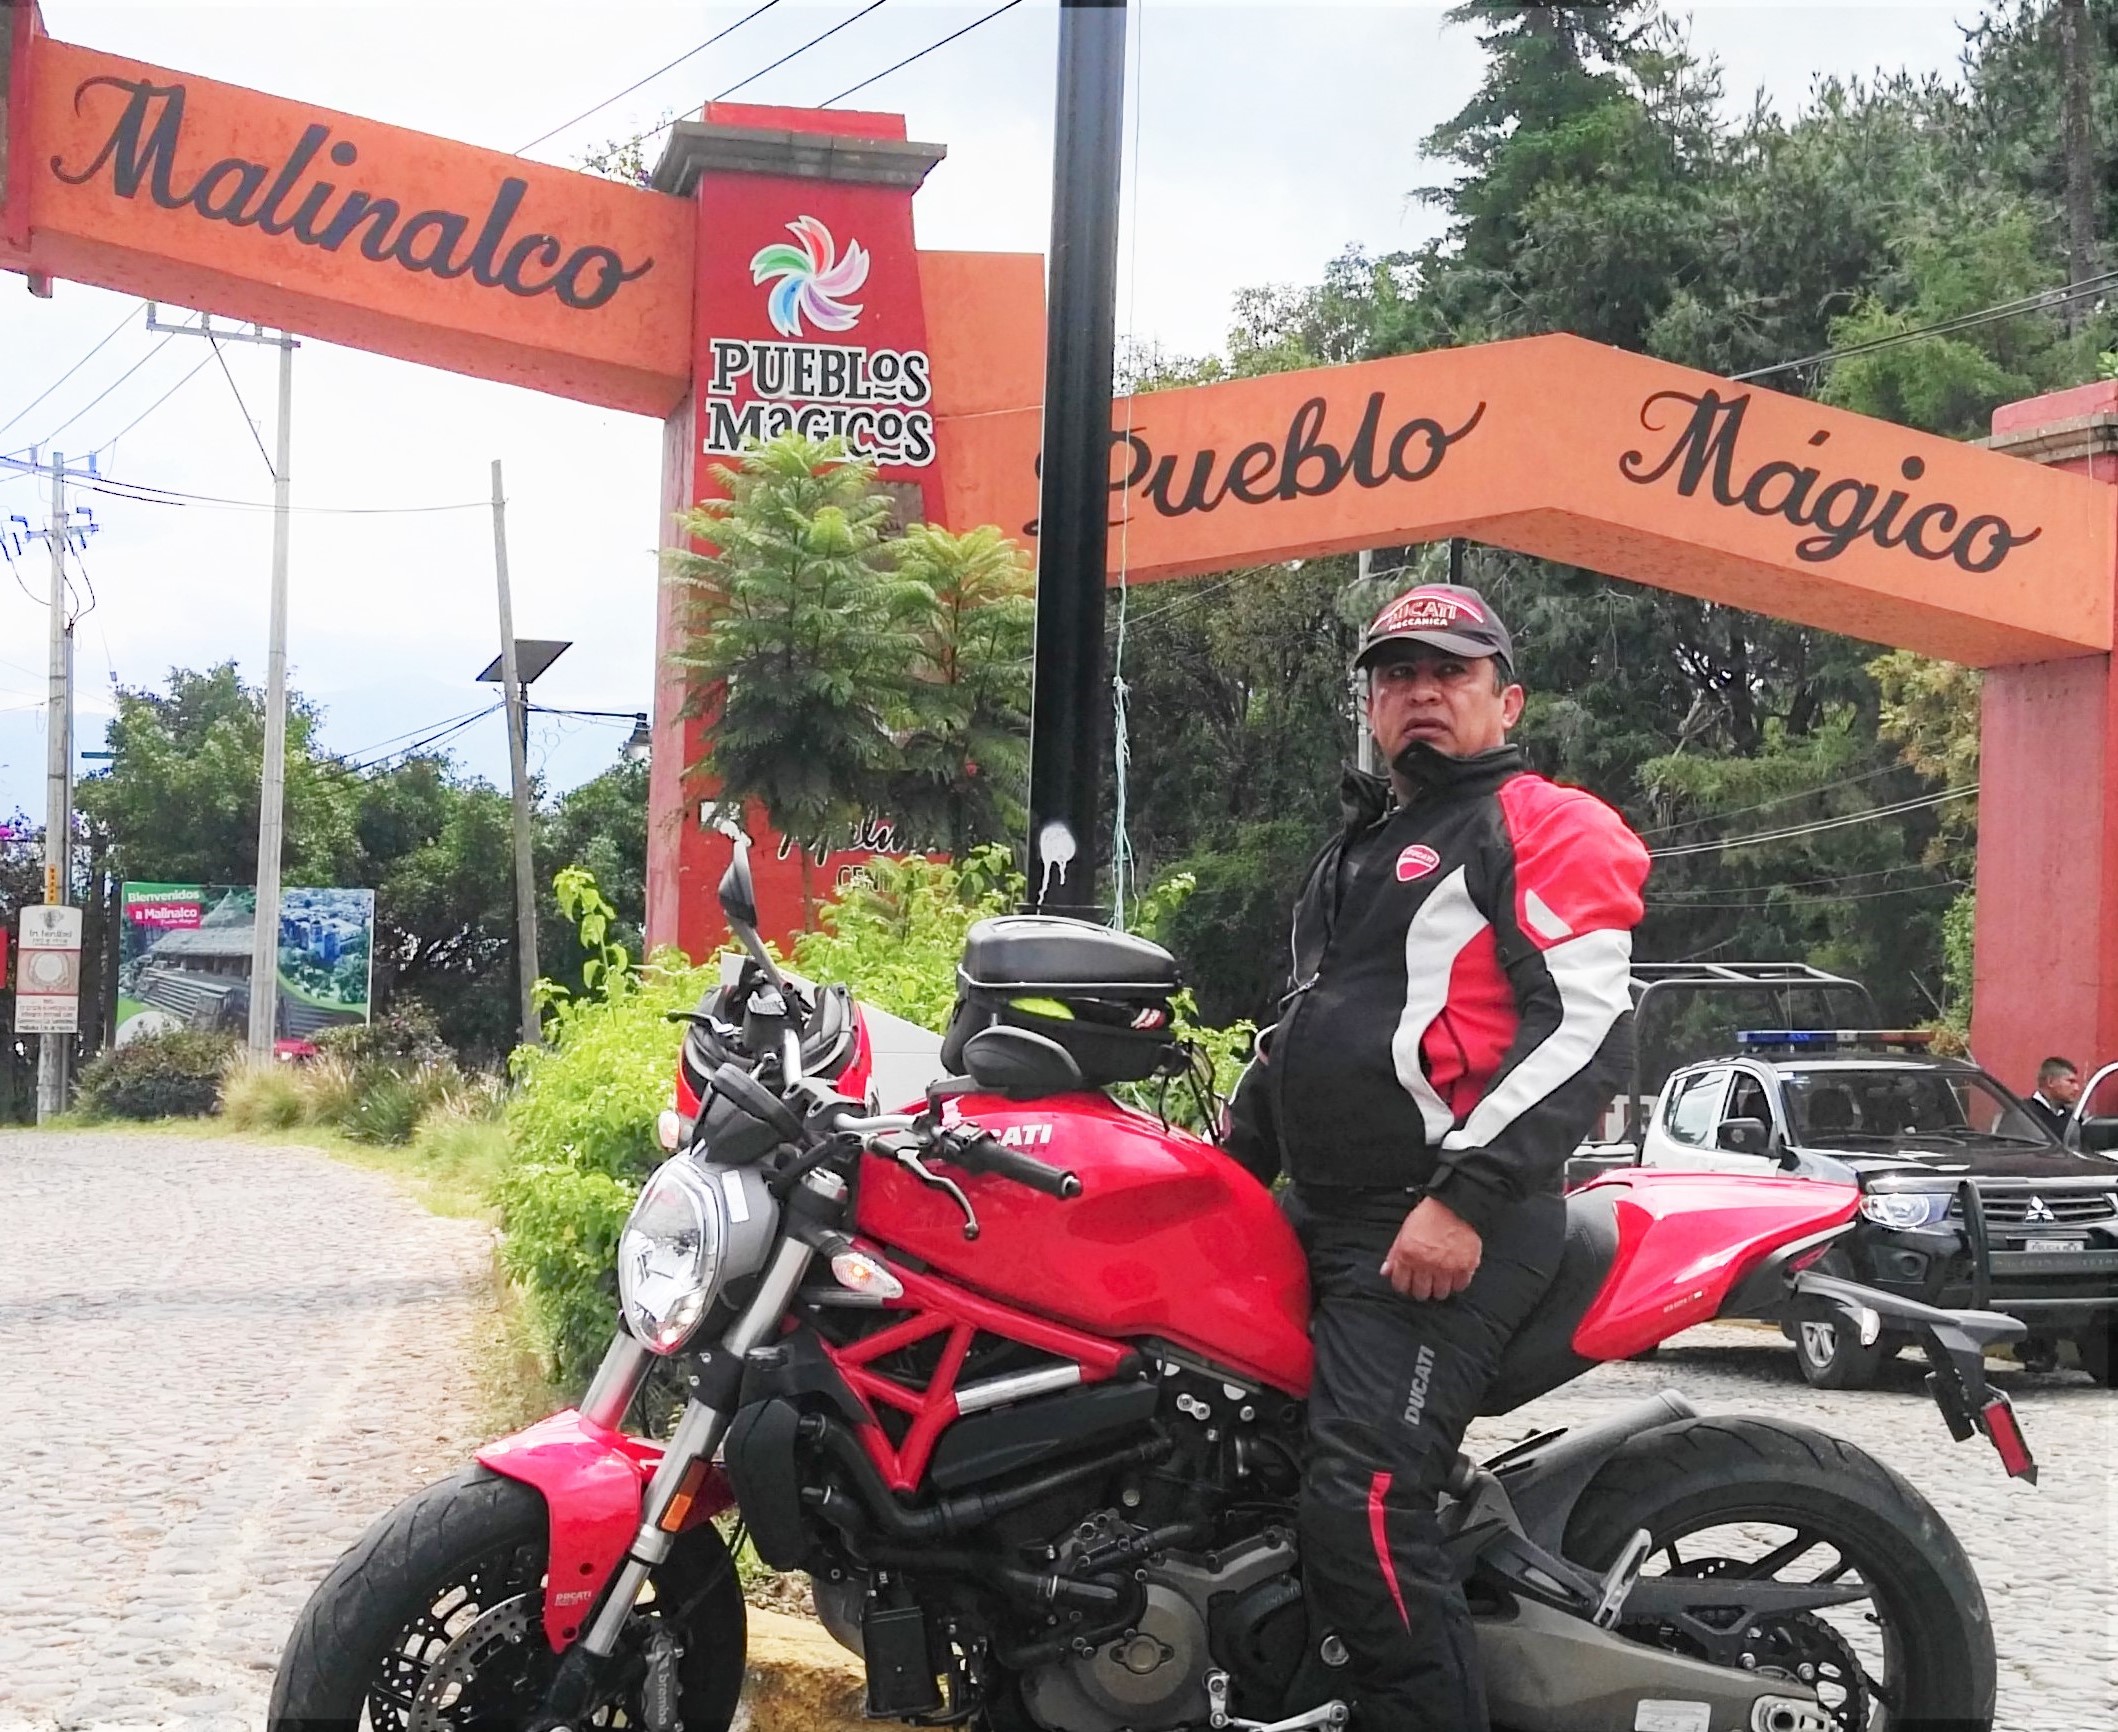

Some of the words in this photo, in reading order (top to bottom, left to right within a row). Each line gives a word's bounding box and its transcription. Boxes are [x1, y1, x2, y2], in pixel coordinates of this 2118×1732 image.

[50, 76, 654, 310] Malinalco
[710, 340, 930, 404] PUEBLOS
[706, 400, 934, 463] MAGICOS
[1619, 389, 2042, 573] Mágico
[1388, 617, 1448, 631] MECCANICA
[127, 889, 200, 902] Bienvenidos
[144, 907, 198, 919] Malinalco
[1404, 1345, 1436, 1425] DUCATI
[556, 1591, 592, 1602] DUCATI
[658, 1672, 670, 1725] brembo
